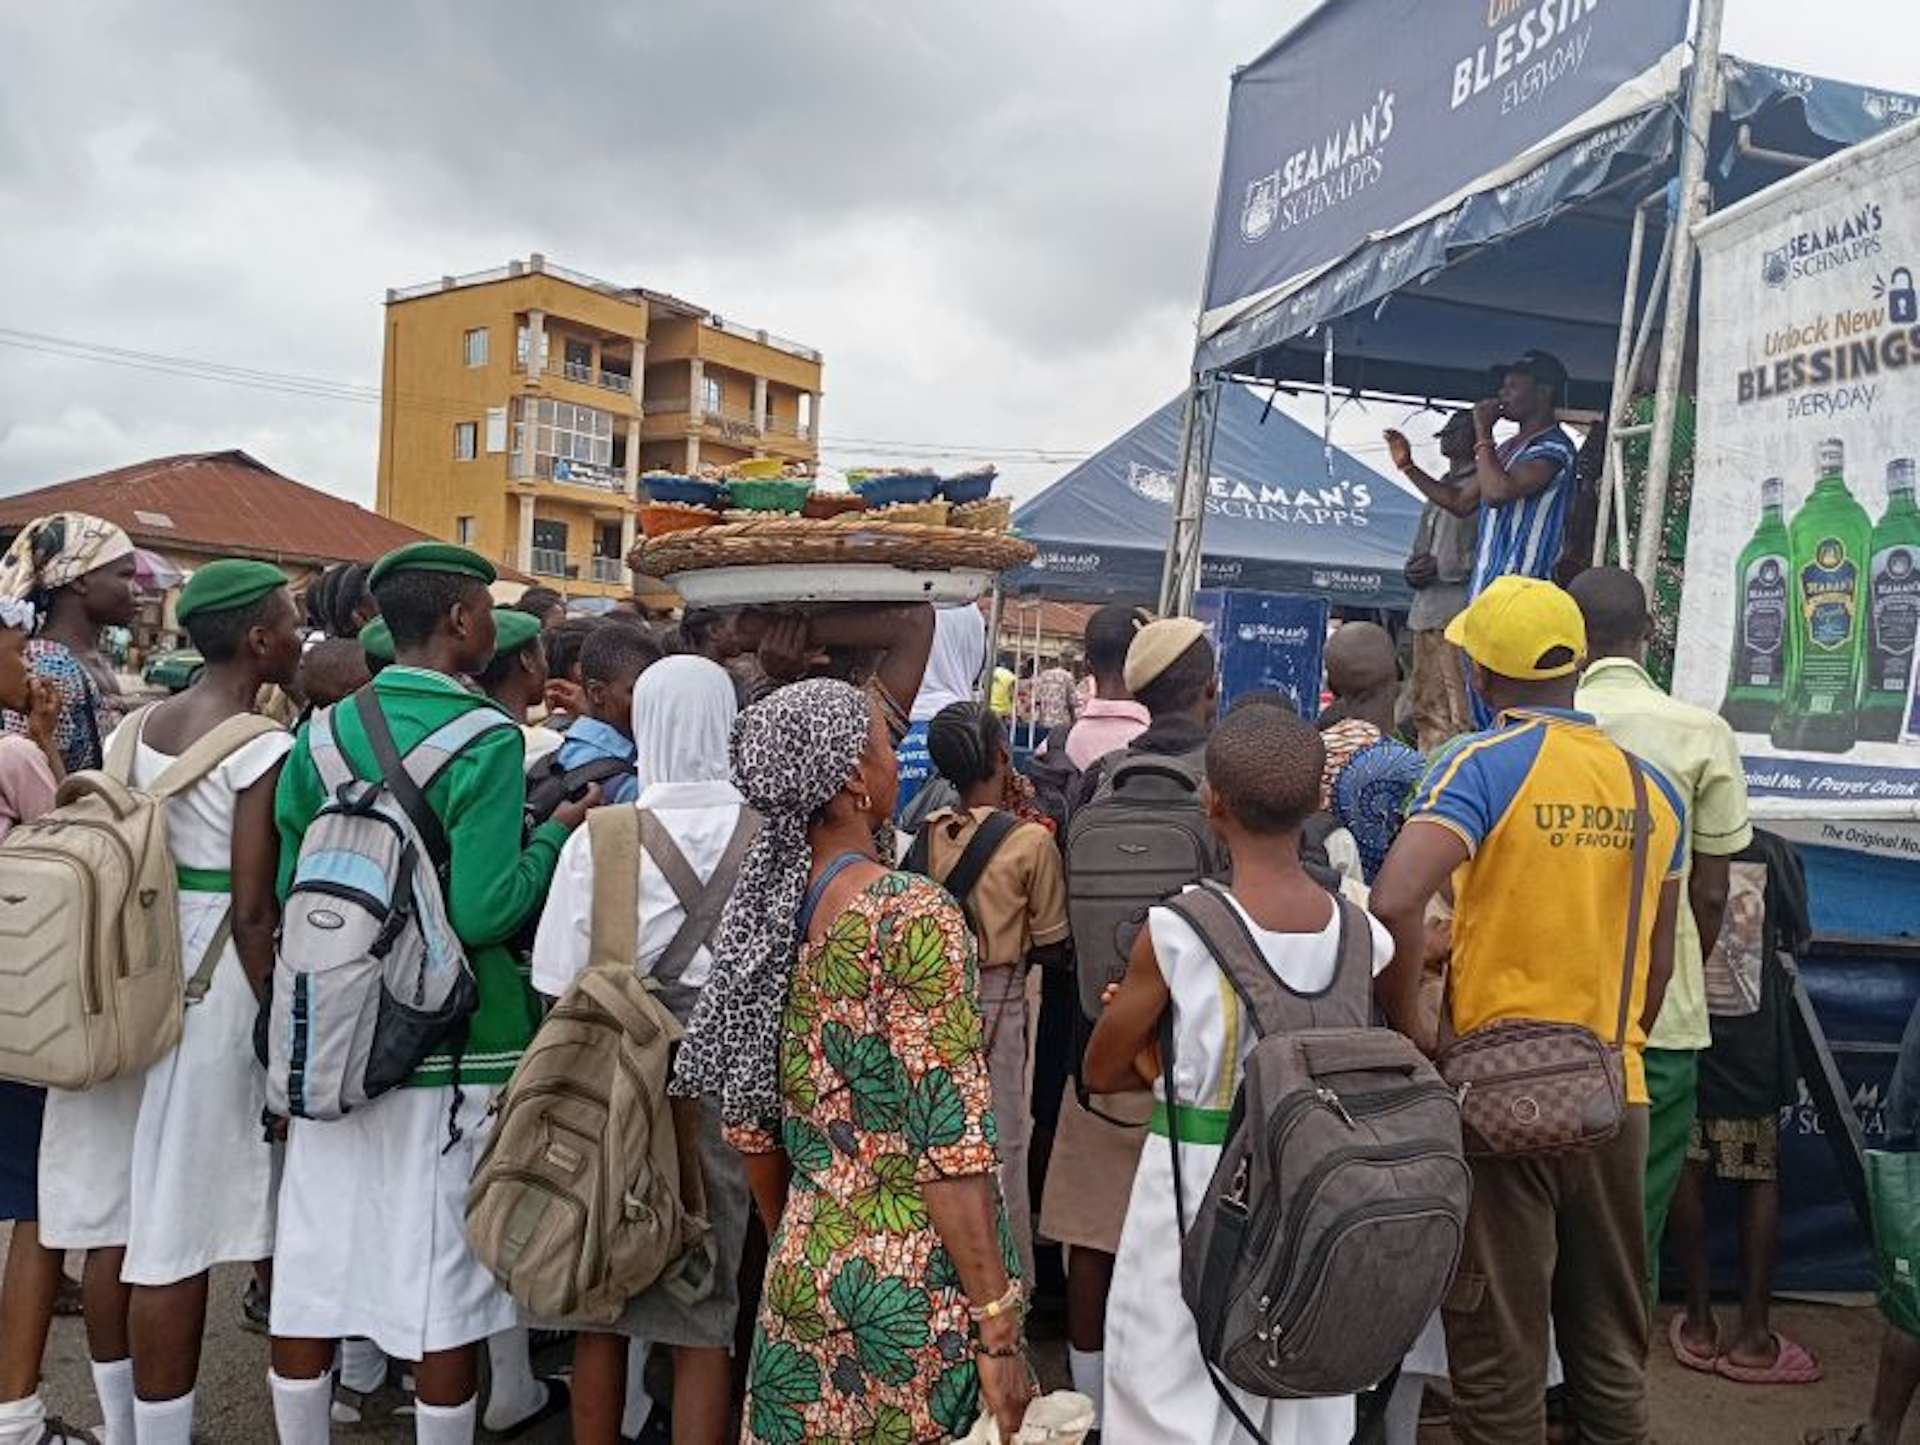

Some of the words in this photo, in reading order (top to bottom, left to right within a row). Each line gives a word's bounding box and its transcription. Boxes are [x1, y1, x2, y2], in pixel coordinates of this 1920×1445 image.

[1280, 90, 1395, 198] SEAMAN'S
[1281, 147, 1383, 231] SCHNAPPS
[1789, 203, 1882, 260] SEAMAN'S
[1792, 233, 1882, 280] SCHNAPPS
[1765, 313, 1829, 357] Unlock
[1835, 308, 1884, 339] New
[1206, 477, 1371, 507] EAMAN'S
[1204, 498, 1368, 527] SCHNAPPS
[1815, 776, 1868, 796] Prayer
[1868, 779, 1919, 796] Drink
[1535, 804, 1575, 830] UP
[1574, 833, 1635, 850] FAVOU
[1821, 824, 1844, 840] The
[1845, 828, 1899, 850] Original
